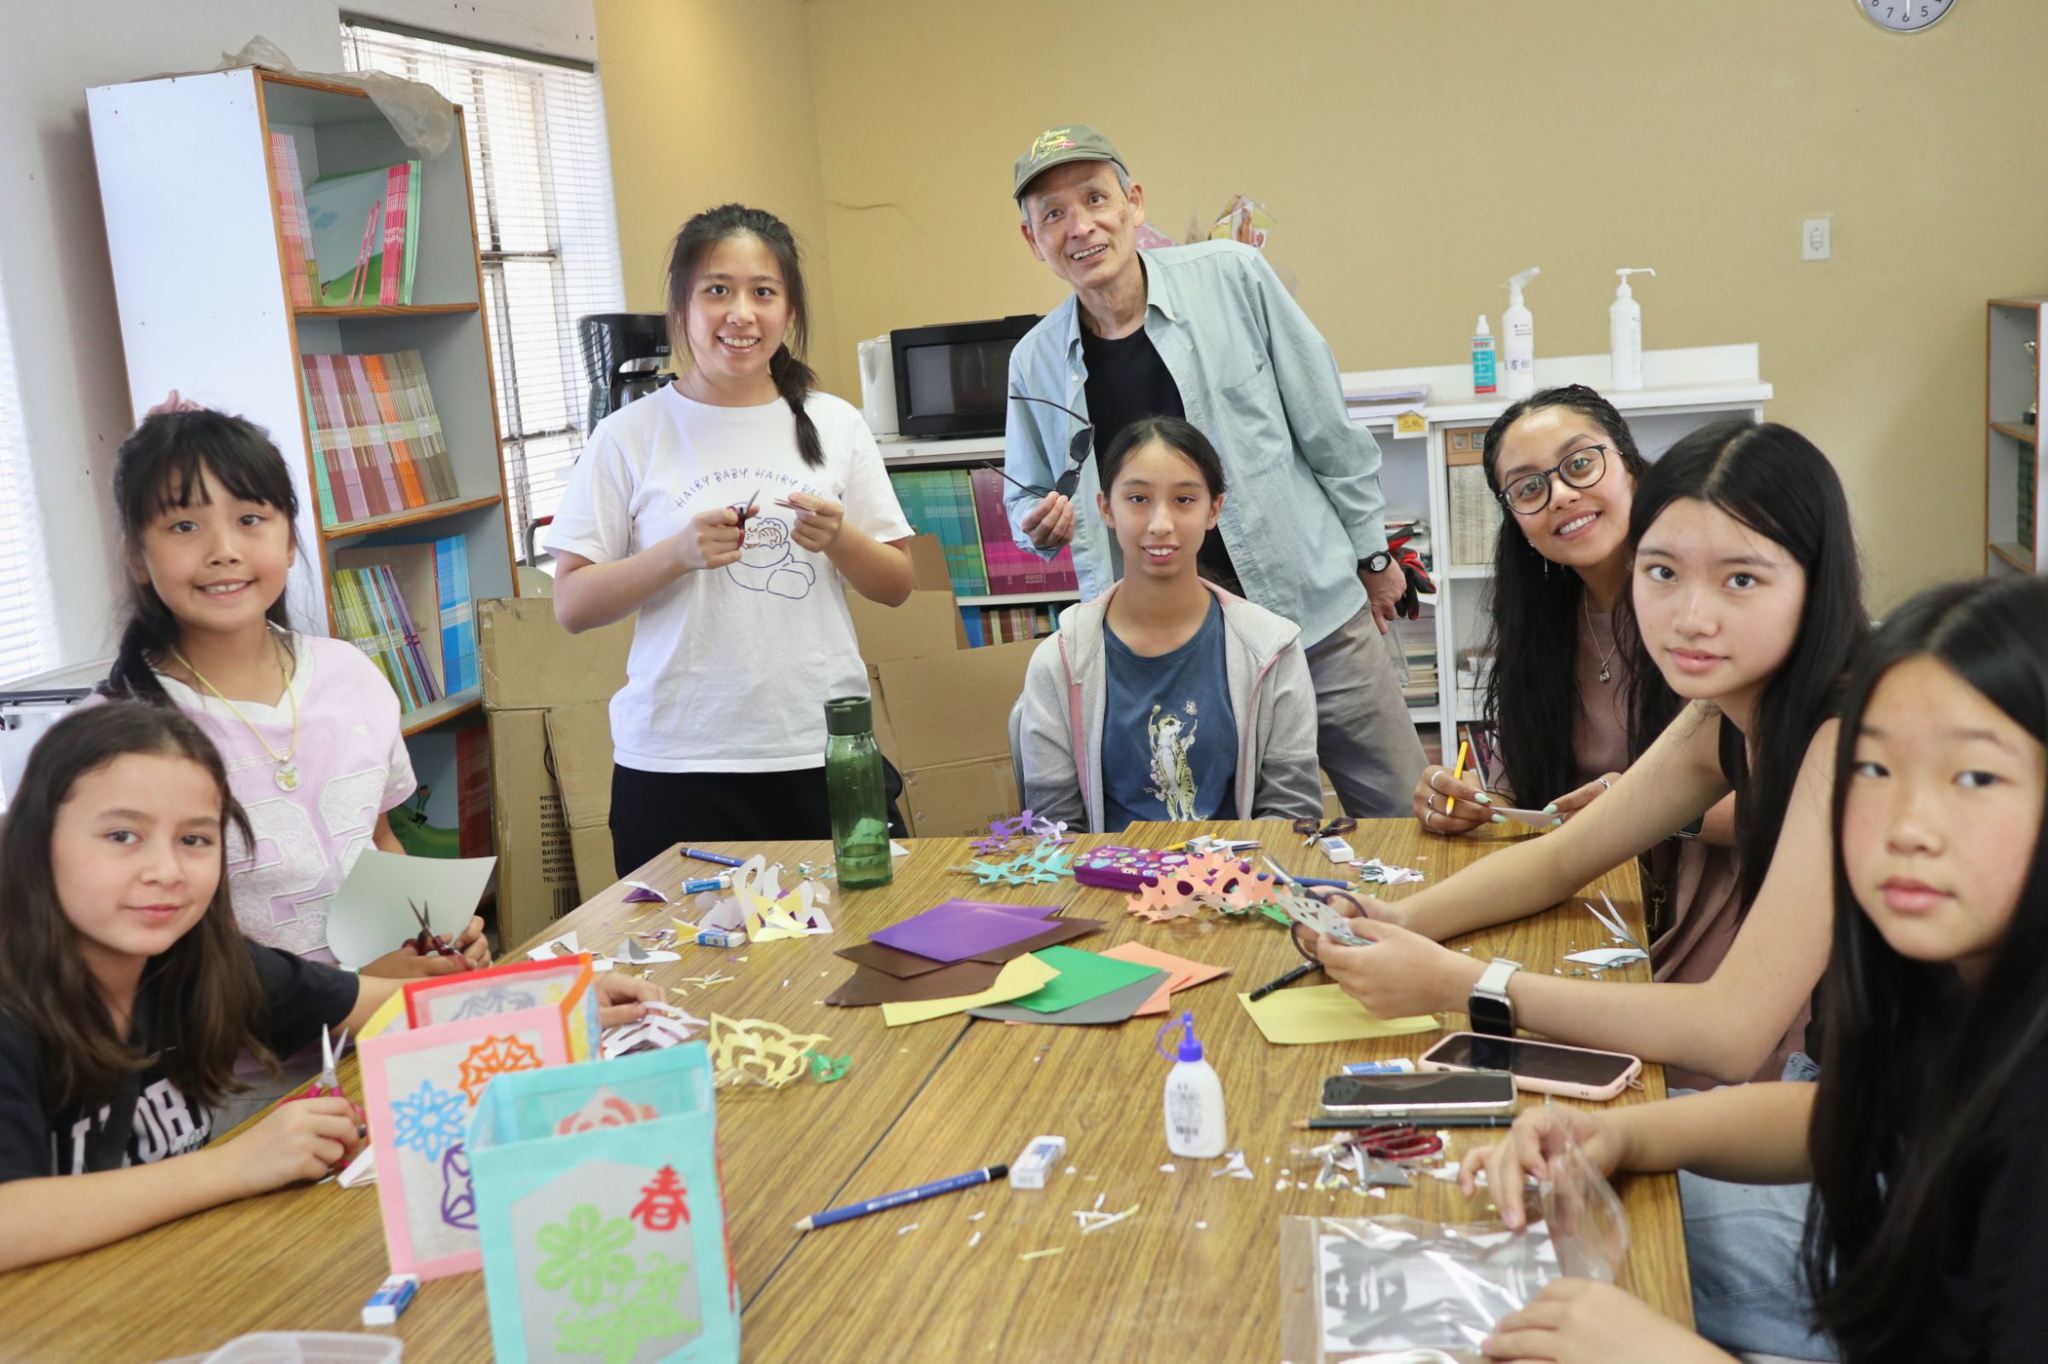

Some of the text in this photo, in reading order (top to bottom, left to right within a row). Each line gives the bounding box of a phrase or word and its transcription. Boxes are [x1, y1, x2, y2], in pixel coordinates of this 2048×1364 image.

[1886, 7, 1894, 19] 7
[1920, 6, 1929, 18] 5
[674, 475, 710, 509] HAIRY
[755, 468, 798, 489] HAIRY
[630, 1163, 691, 1232] 春
